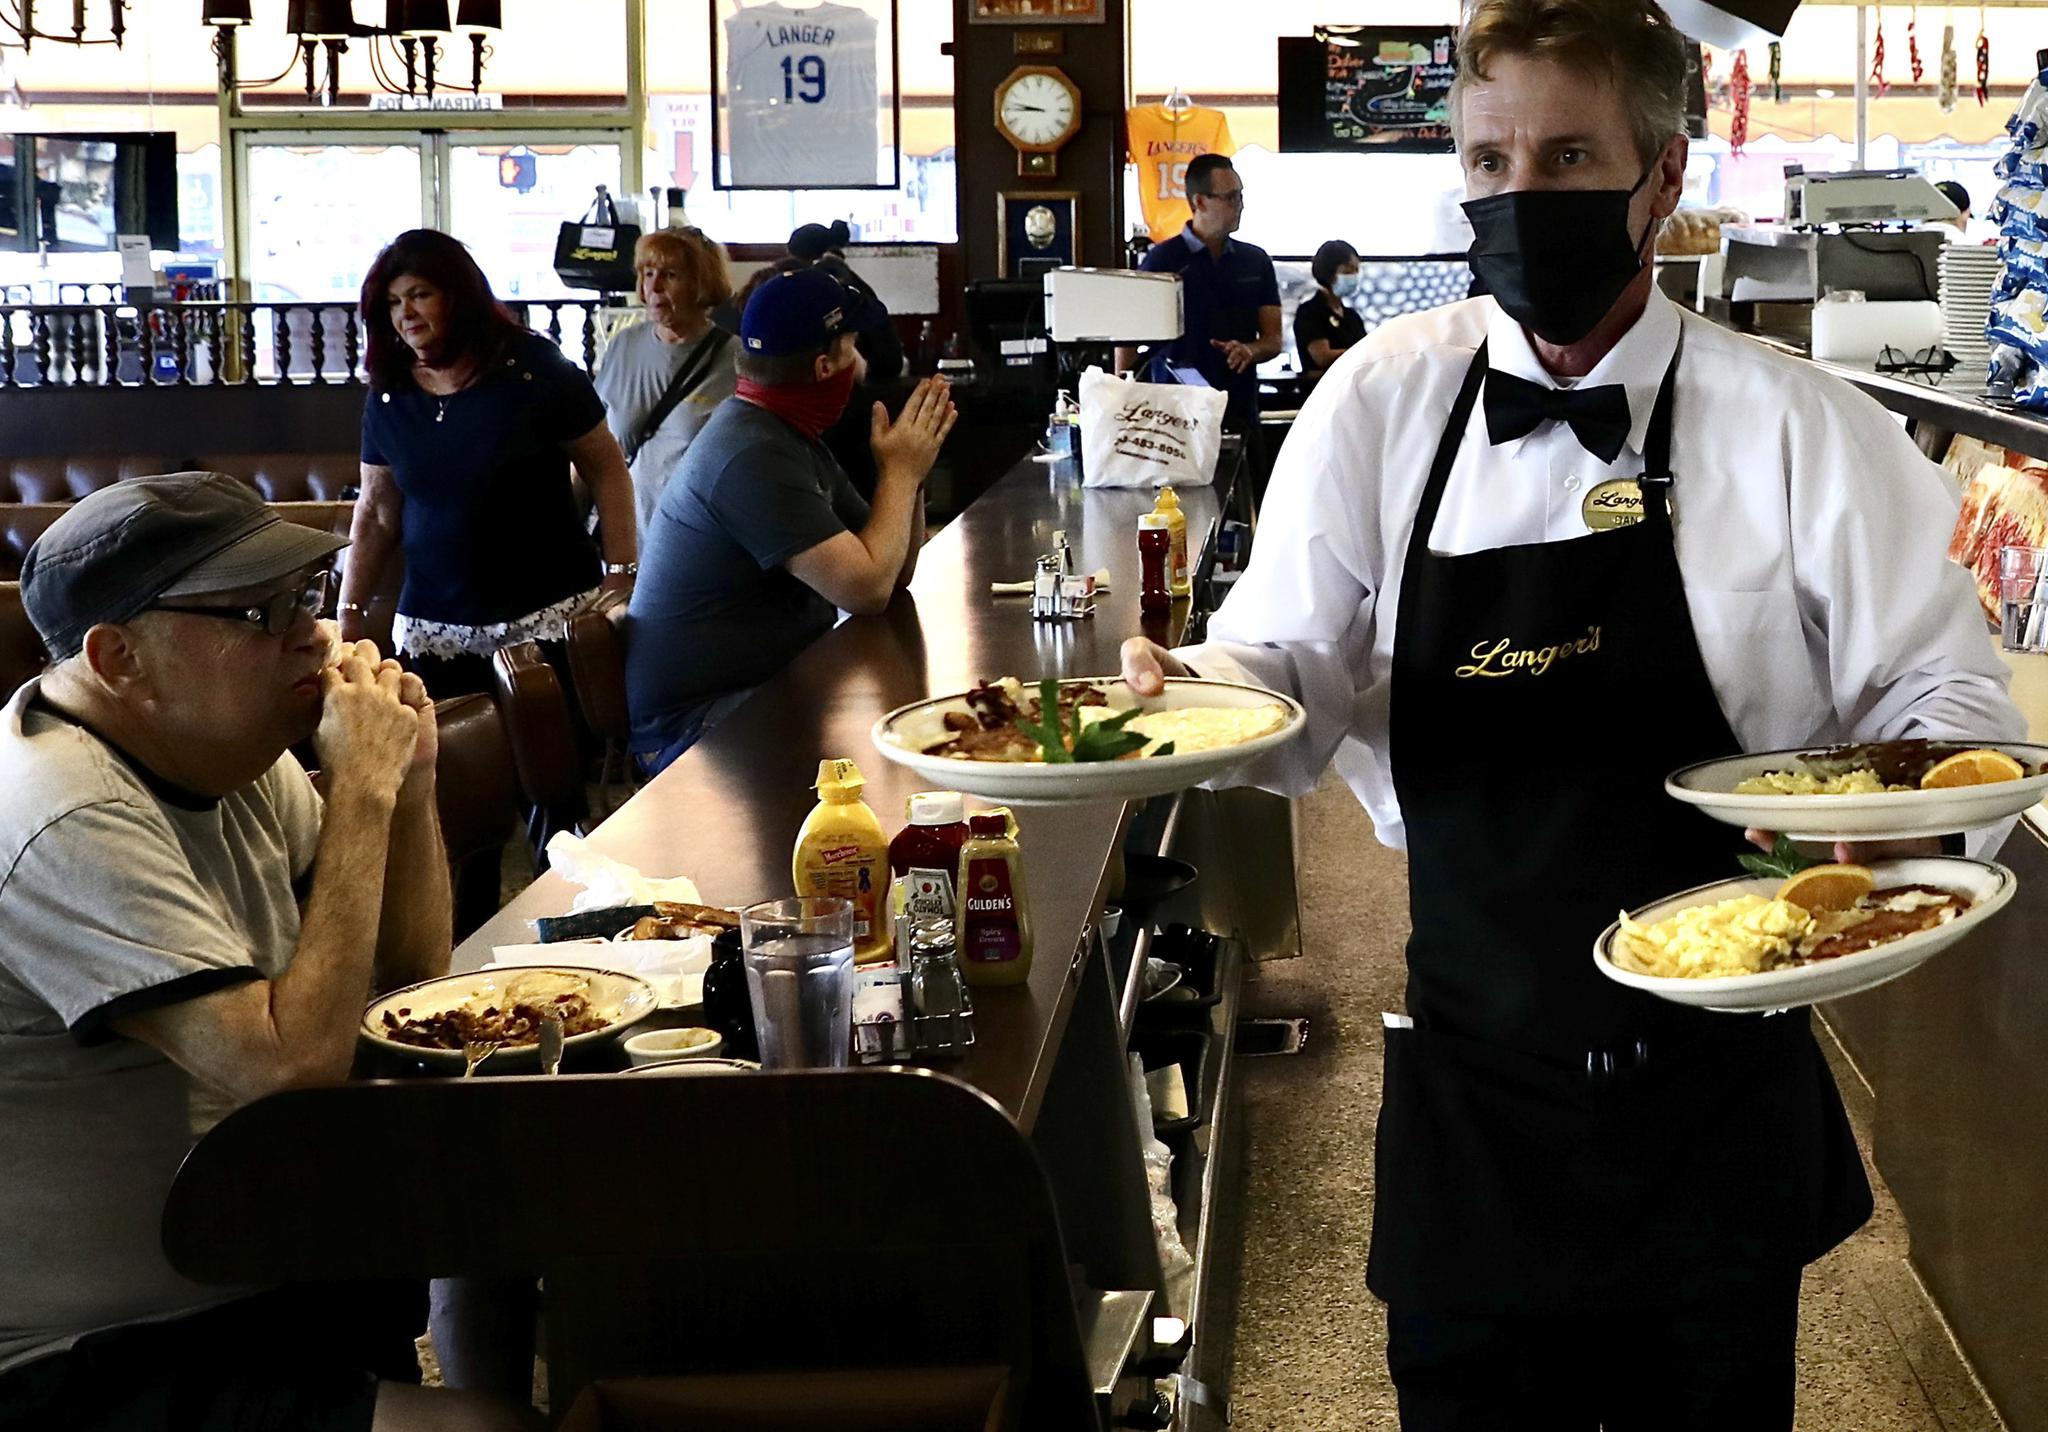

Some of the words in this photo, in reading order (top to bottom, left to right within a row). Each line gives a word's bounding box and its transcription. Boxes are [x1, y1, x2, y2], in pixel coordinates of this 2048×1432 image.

[766, 24, 835, 48] LANGER
[780, 55, 827, 104] 19
[1455, 625, 1602, 678] Langer's
[913, 903, 944, 914] TOMATO
[967, 893, 1012, 911] GULDEN'S
